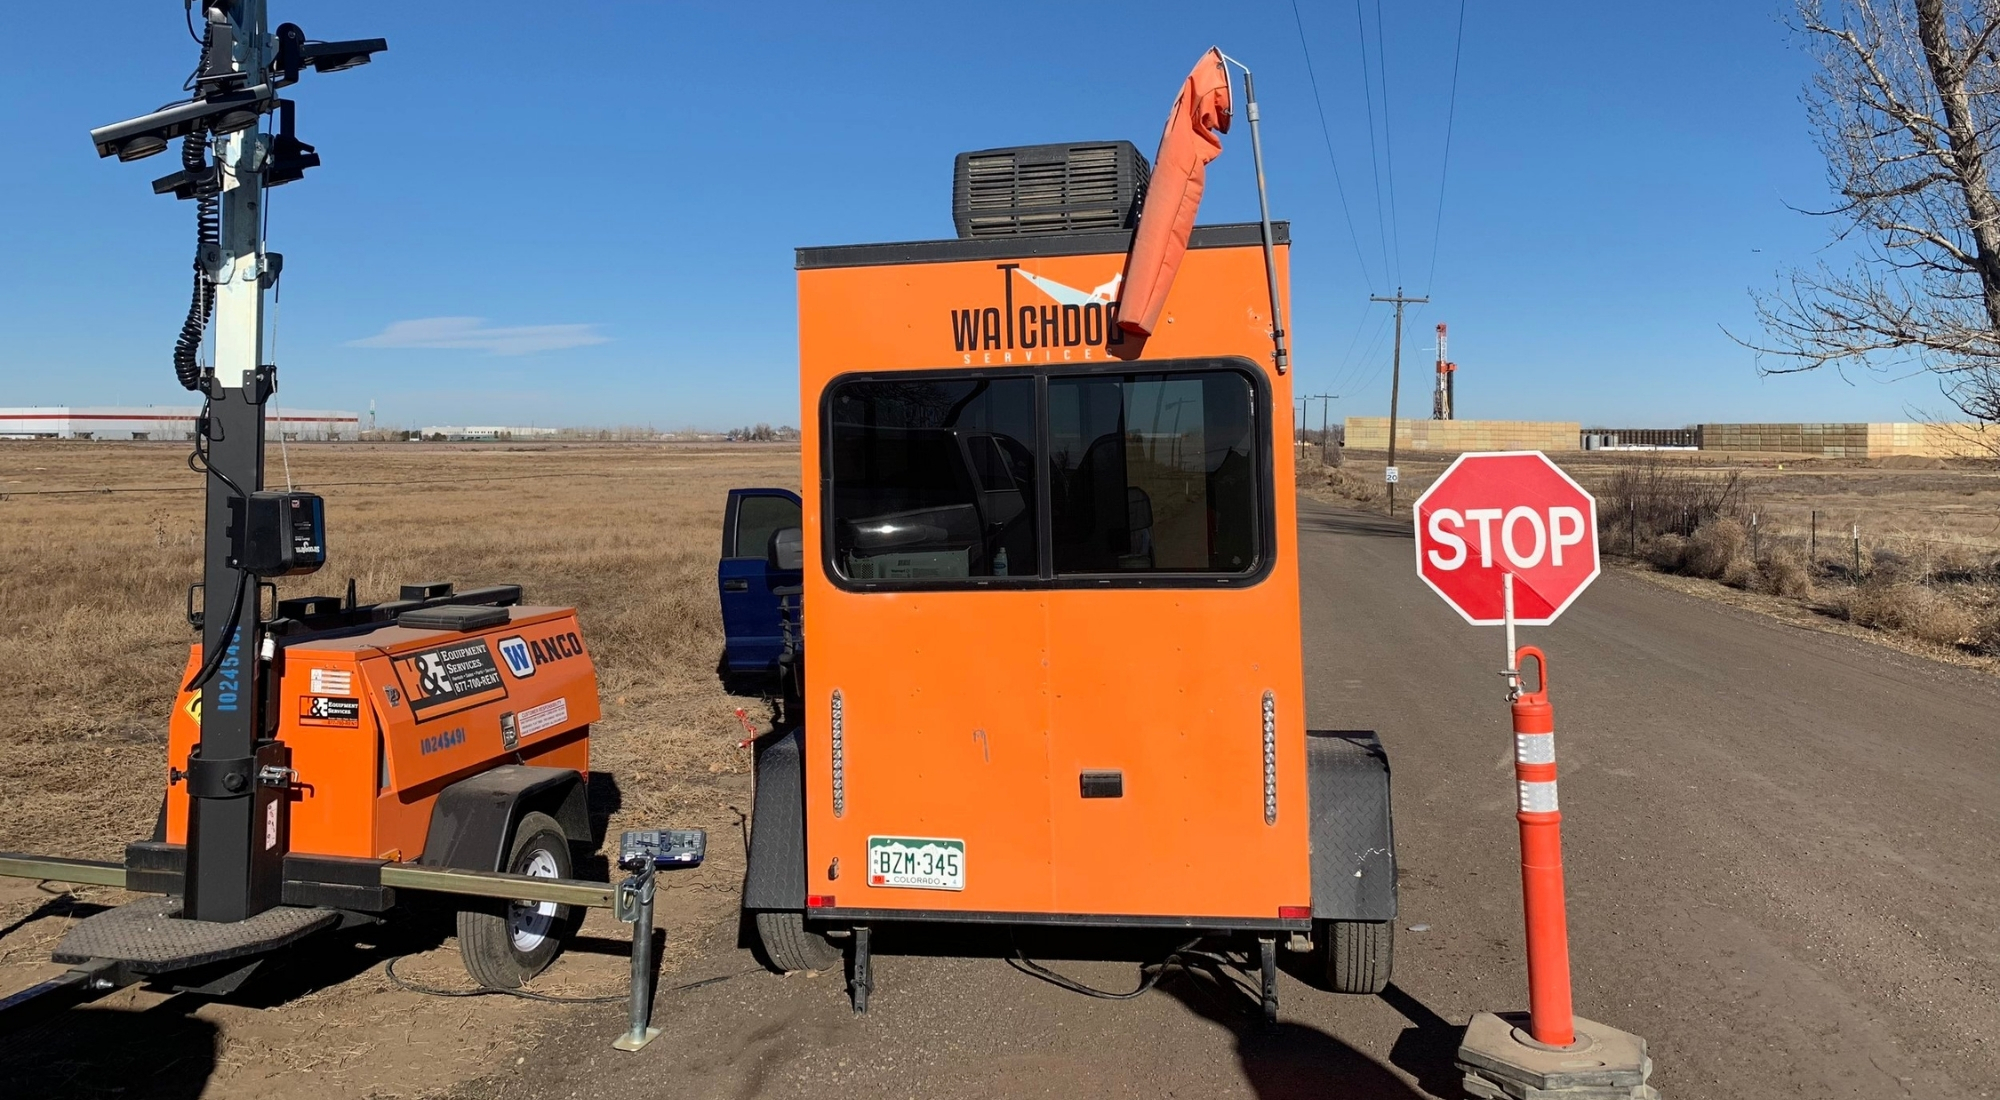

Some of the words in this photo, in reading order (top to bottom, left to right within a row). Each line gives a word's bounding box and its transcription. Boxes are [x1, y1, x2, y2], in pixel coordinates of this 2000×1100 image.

[951, 264, 1125, 352] WATCHDOG
[963, 348, 1114, 365] SERVICES
[1428, 505, 1585, 571] STOP
[440, 644, 487, 661] EQUIPMENT
[502, 632, 583, 672] WANCO
[393, 652, 453, 702] H&E
[446, 658, 482, 674] SERVICES
[454, 672, 500, 693] 877-700-RENT
[420, 727, 466, 756] 10245491
[893, 876, 940, 885] COLORADO
